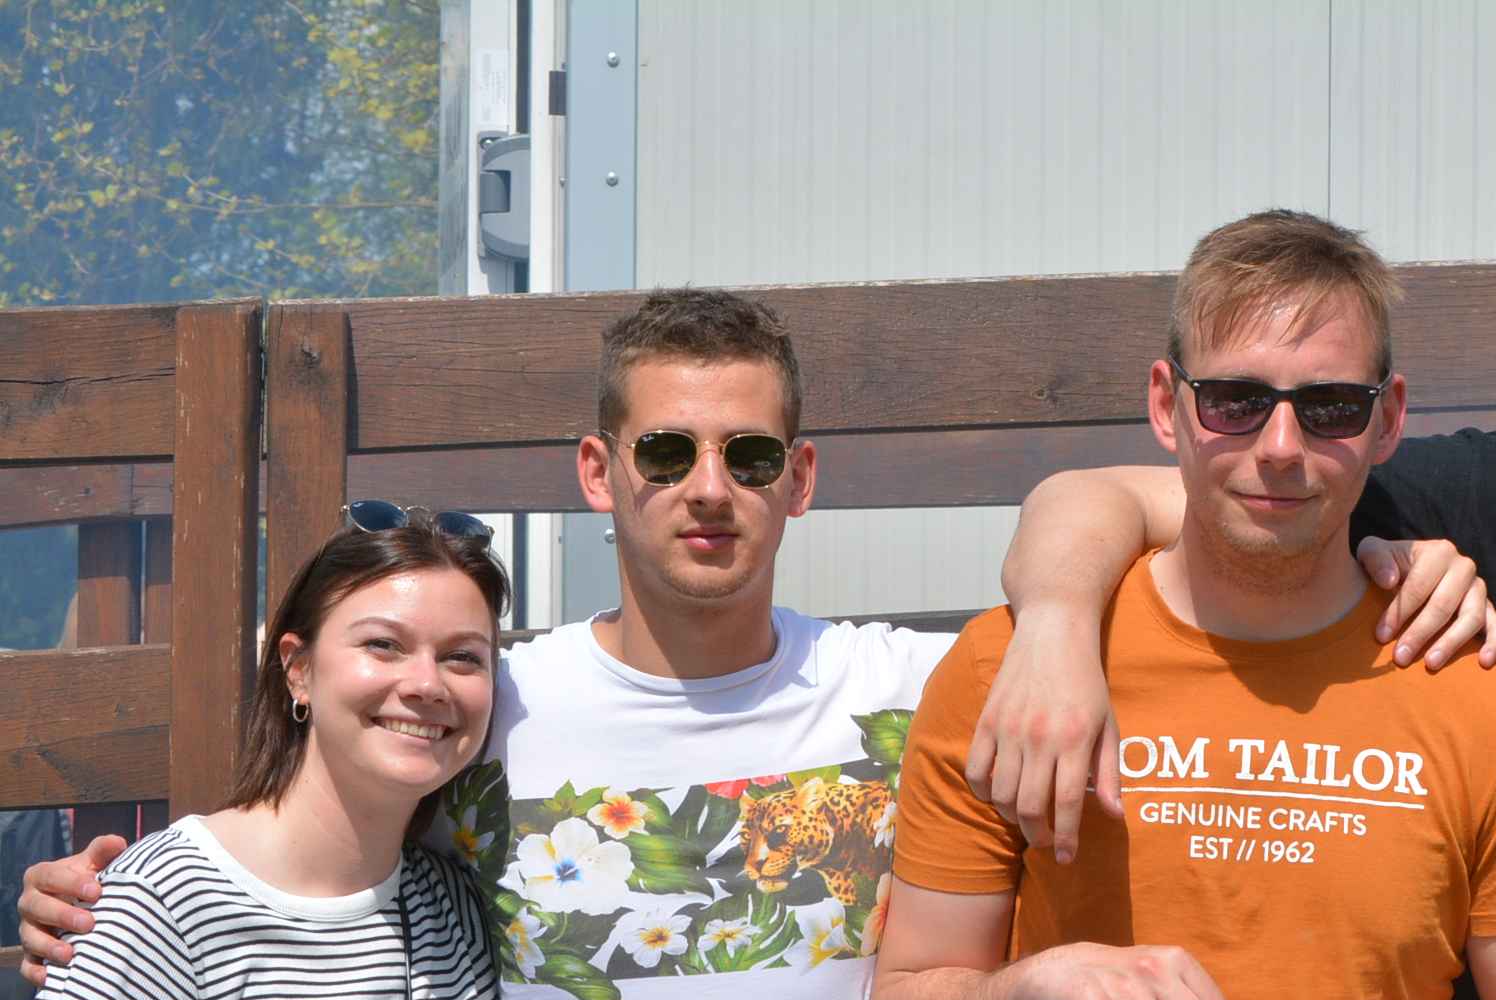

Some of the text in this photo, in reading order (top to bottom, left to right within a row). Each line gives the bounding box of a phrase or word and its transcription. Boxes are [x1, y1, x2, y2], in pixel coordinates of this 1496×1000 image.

[1118, 735, 1428, 796] OM TAILOR
[1139, 802, 1368, 837] GENUINE CRAFTS
[1189, 836, 1233, 861] EST
[1262, 840, 1315, 864] 1962
